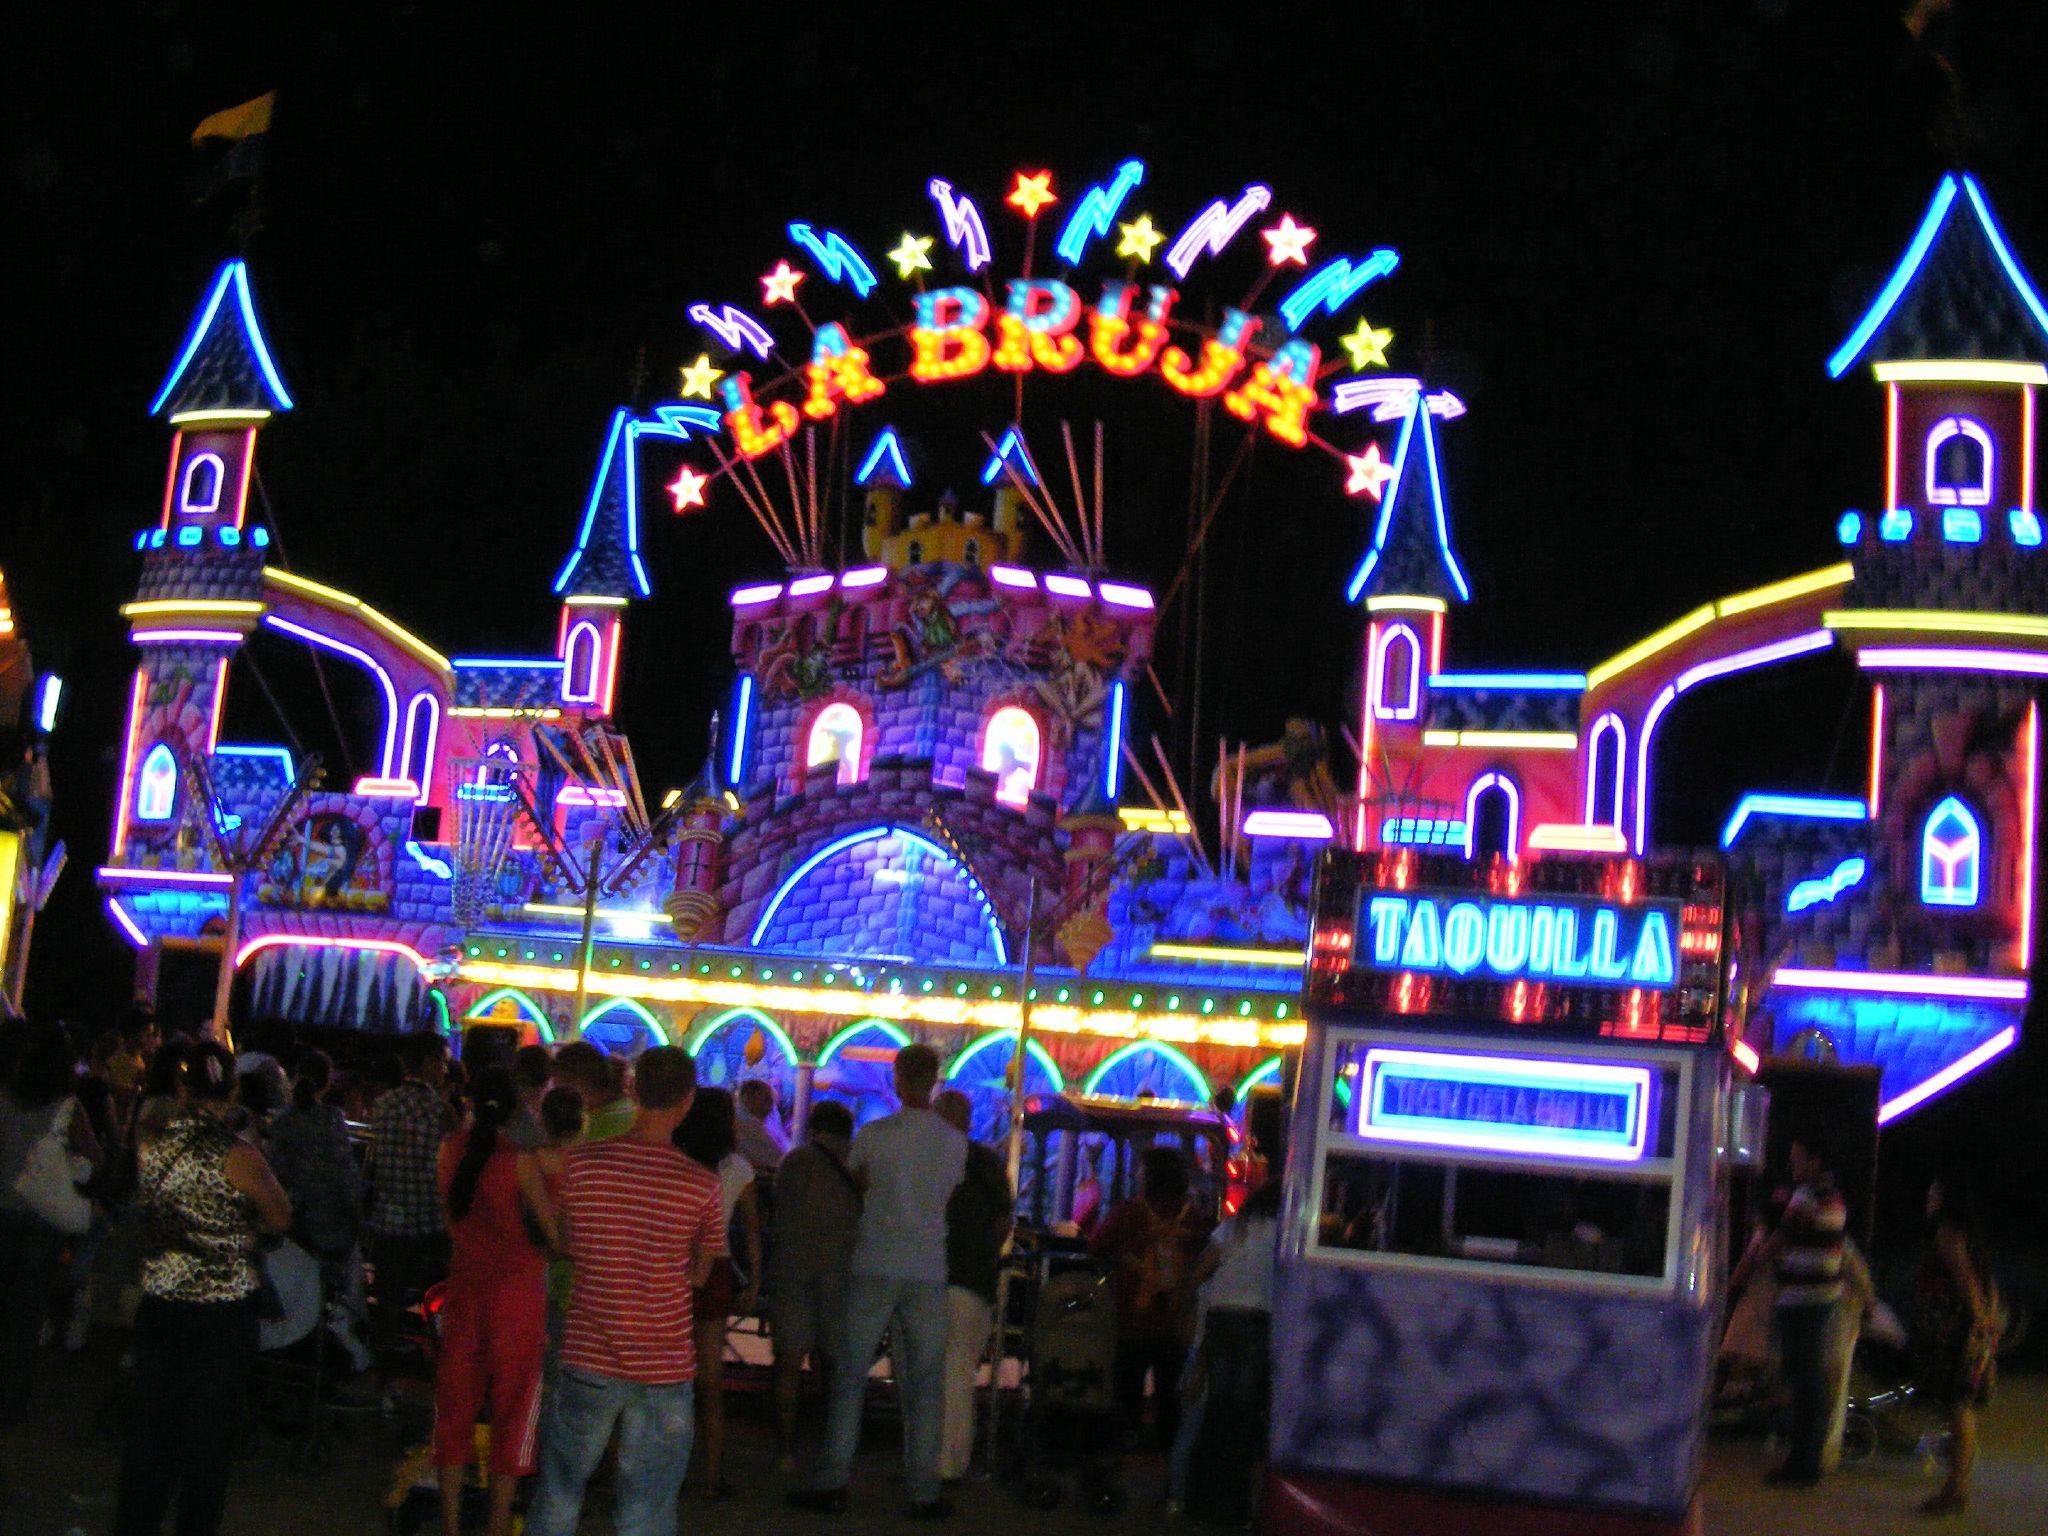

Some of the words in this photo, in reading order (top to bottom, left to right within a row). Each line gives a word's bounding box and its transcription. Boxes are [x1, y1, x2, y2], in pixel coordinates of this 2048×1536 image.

[718, 320, 886, 460] LA
[908, 278, 1321, 448] BRUJA
[1369, 896, 1675, 983] TAQUILLA
